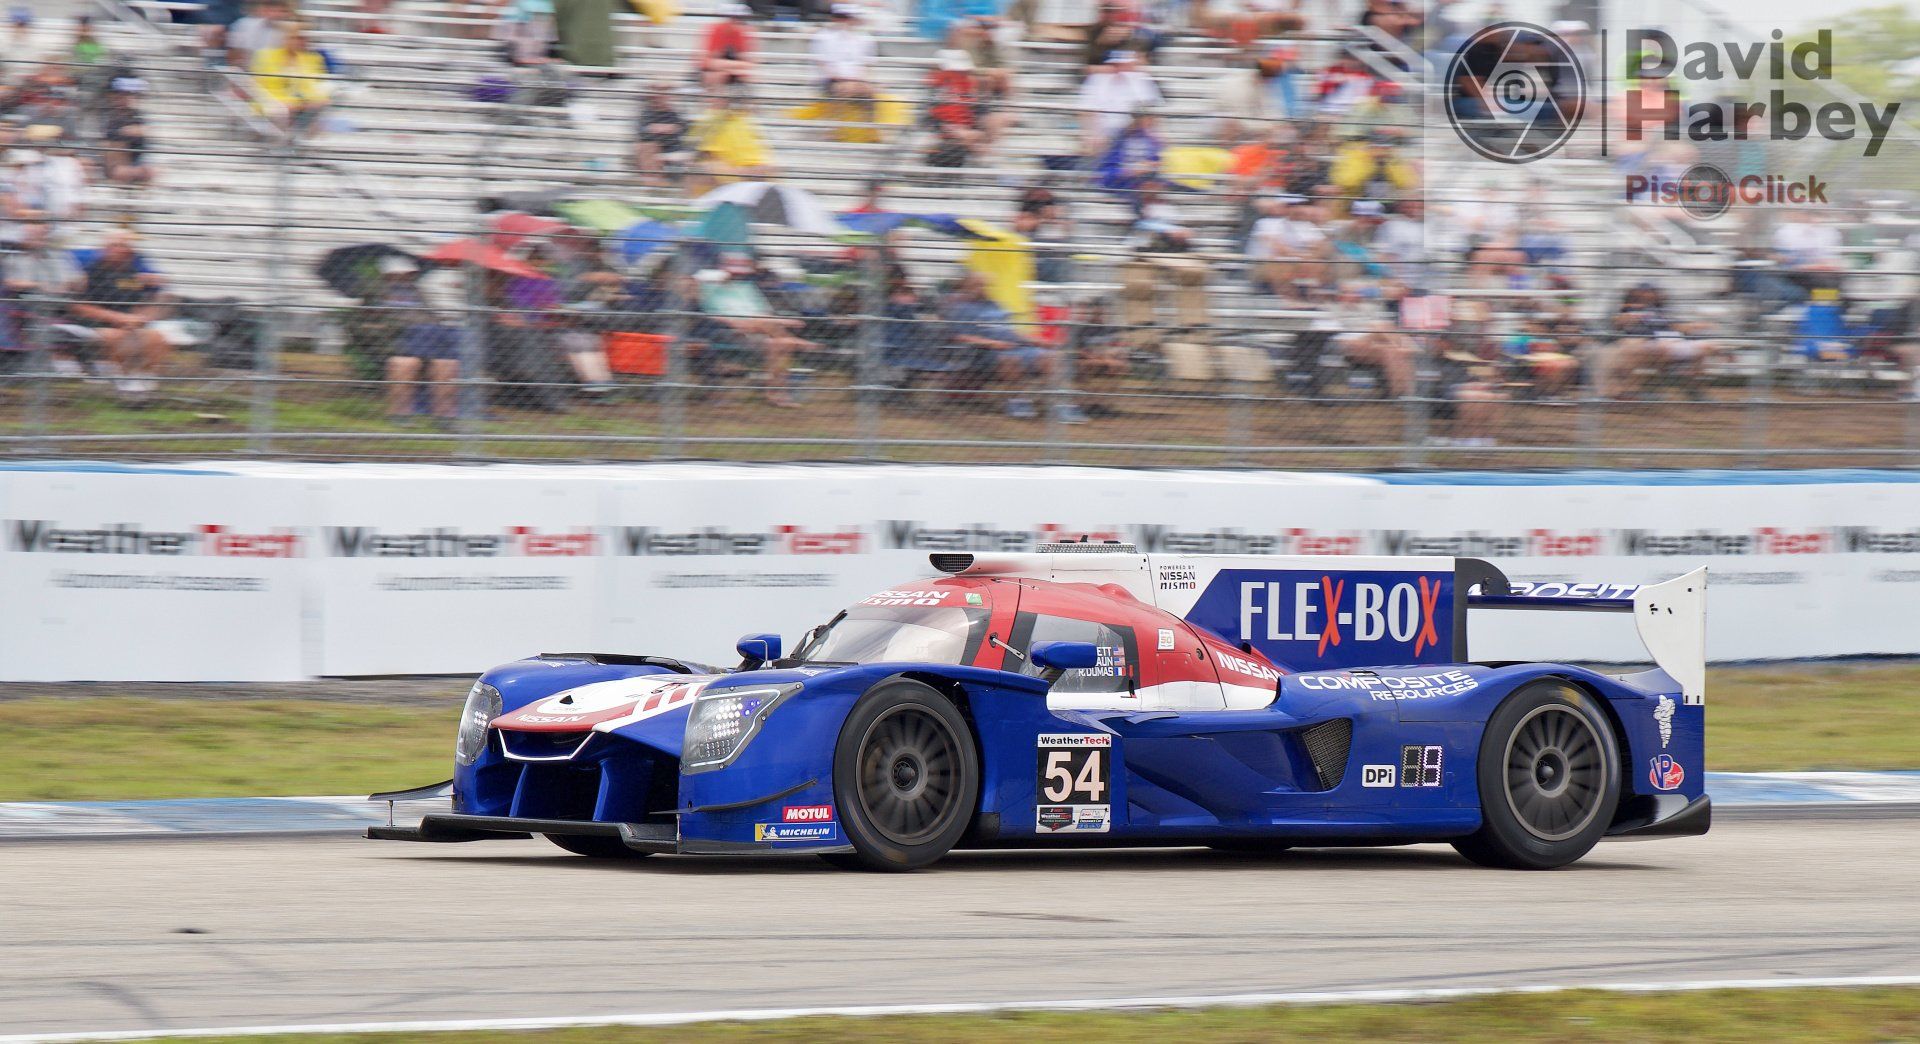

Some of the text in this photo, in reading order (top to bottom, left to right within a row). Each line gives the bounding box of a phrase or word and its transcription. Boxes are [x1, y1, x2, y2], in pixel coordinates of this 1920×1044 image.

[1160, 571, 1196, 580] NISSAN
[1240, 575, 1442, 658] FLEX-BOX
[1216, 650, 1285, 682] NISSAN
[1298, 670, 1471, 691] COMPOSITE
[1369, 679, 1479, 701] RESOURCES
[1040, 736, 1108, 745] WeatherTech
[1043, 750, 1105, 802] 54
[1365, 768, 1392, 783] DPi
[785, 807, 830, 820] MOTUL
[779, 827, 831, 836] MICHELIN
